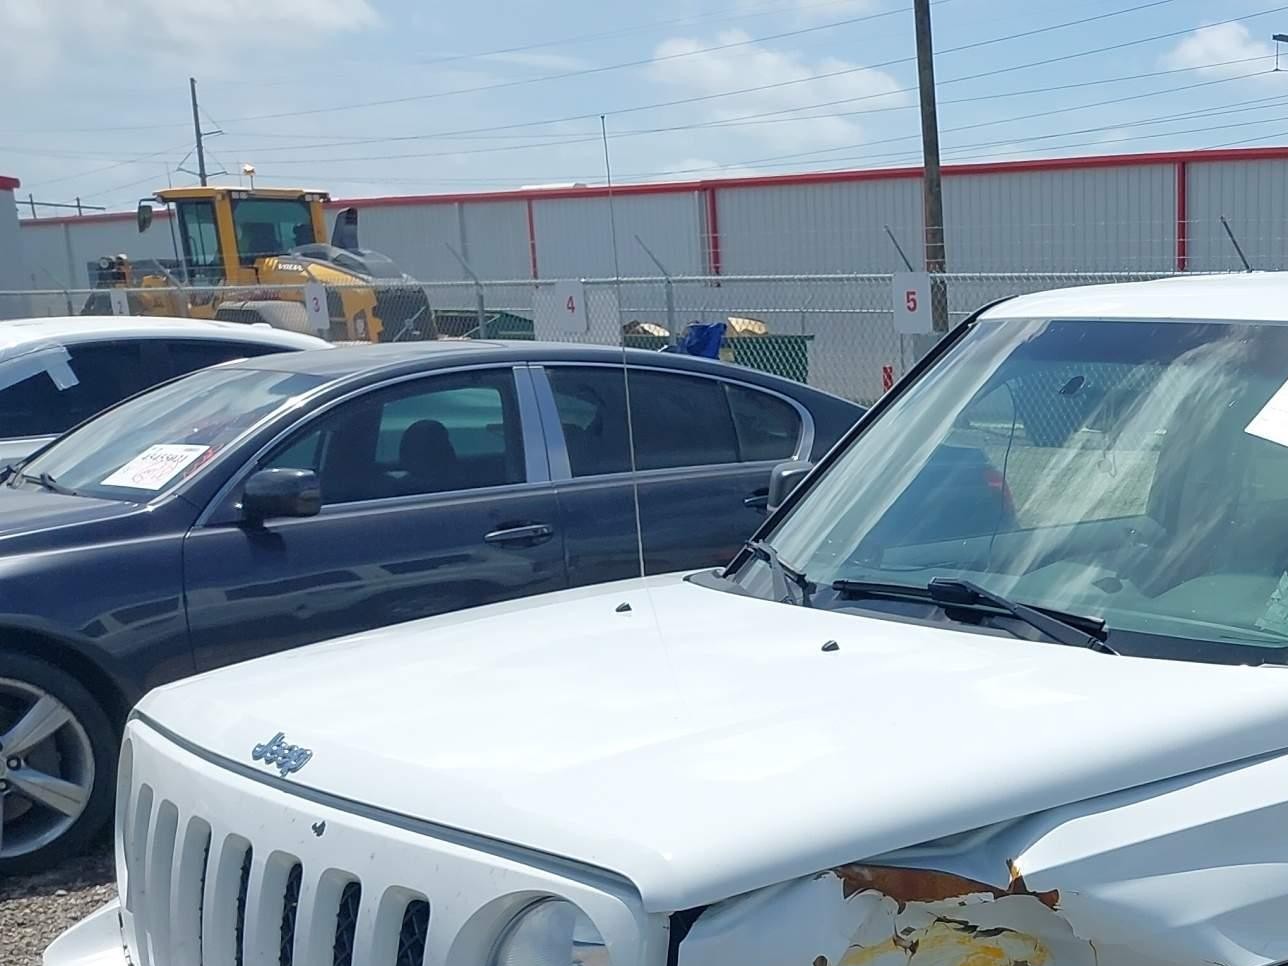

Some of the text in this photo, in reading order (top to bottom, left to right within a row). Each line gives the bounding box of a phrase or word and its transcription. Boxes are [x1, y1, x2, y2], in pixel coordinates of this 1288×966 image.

[311, 297, 321, 313] 3
[567, 295, 575, 313] 4
[906, 291, 918, 312] 5
[252, 731, 313, 777] Jeep
